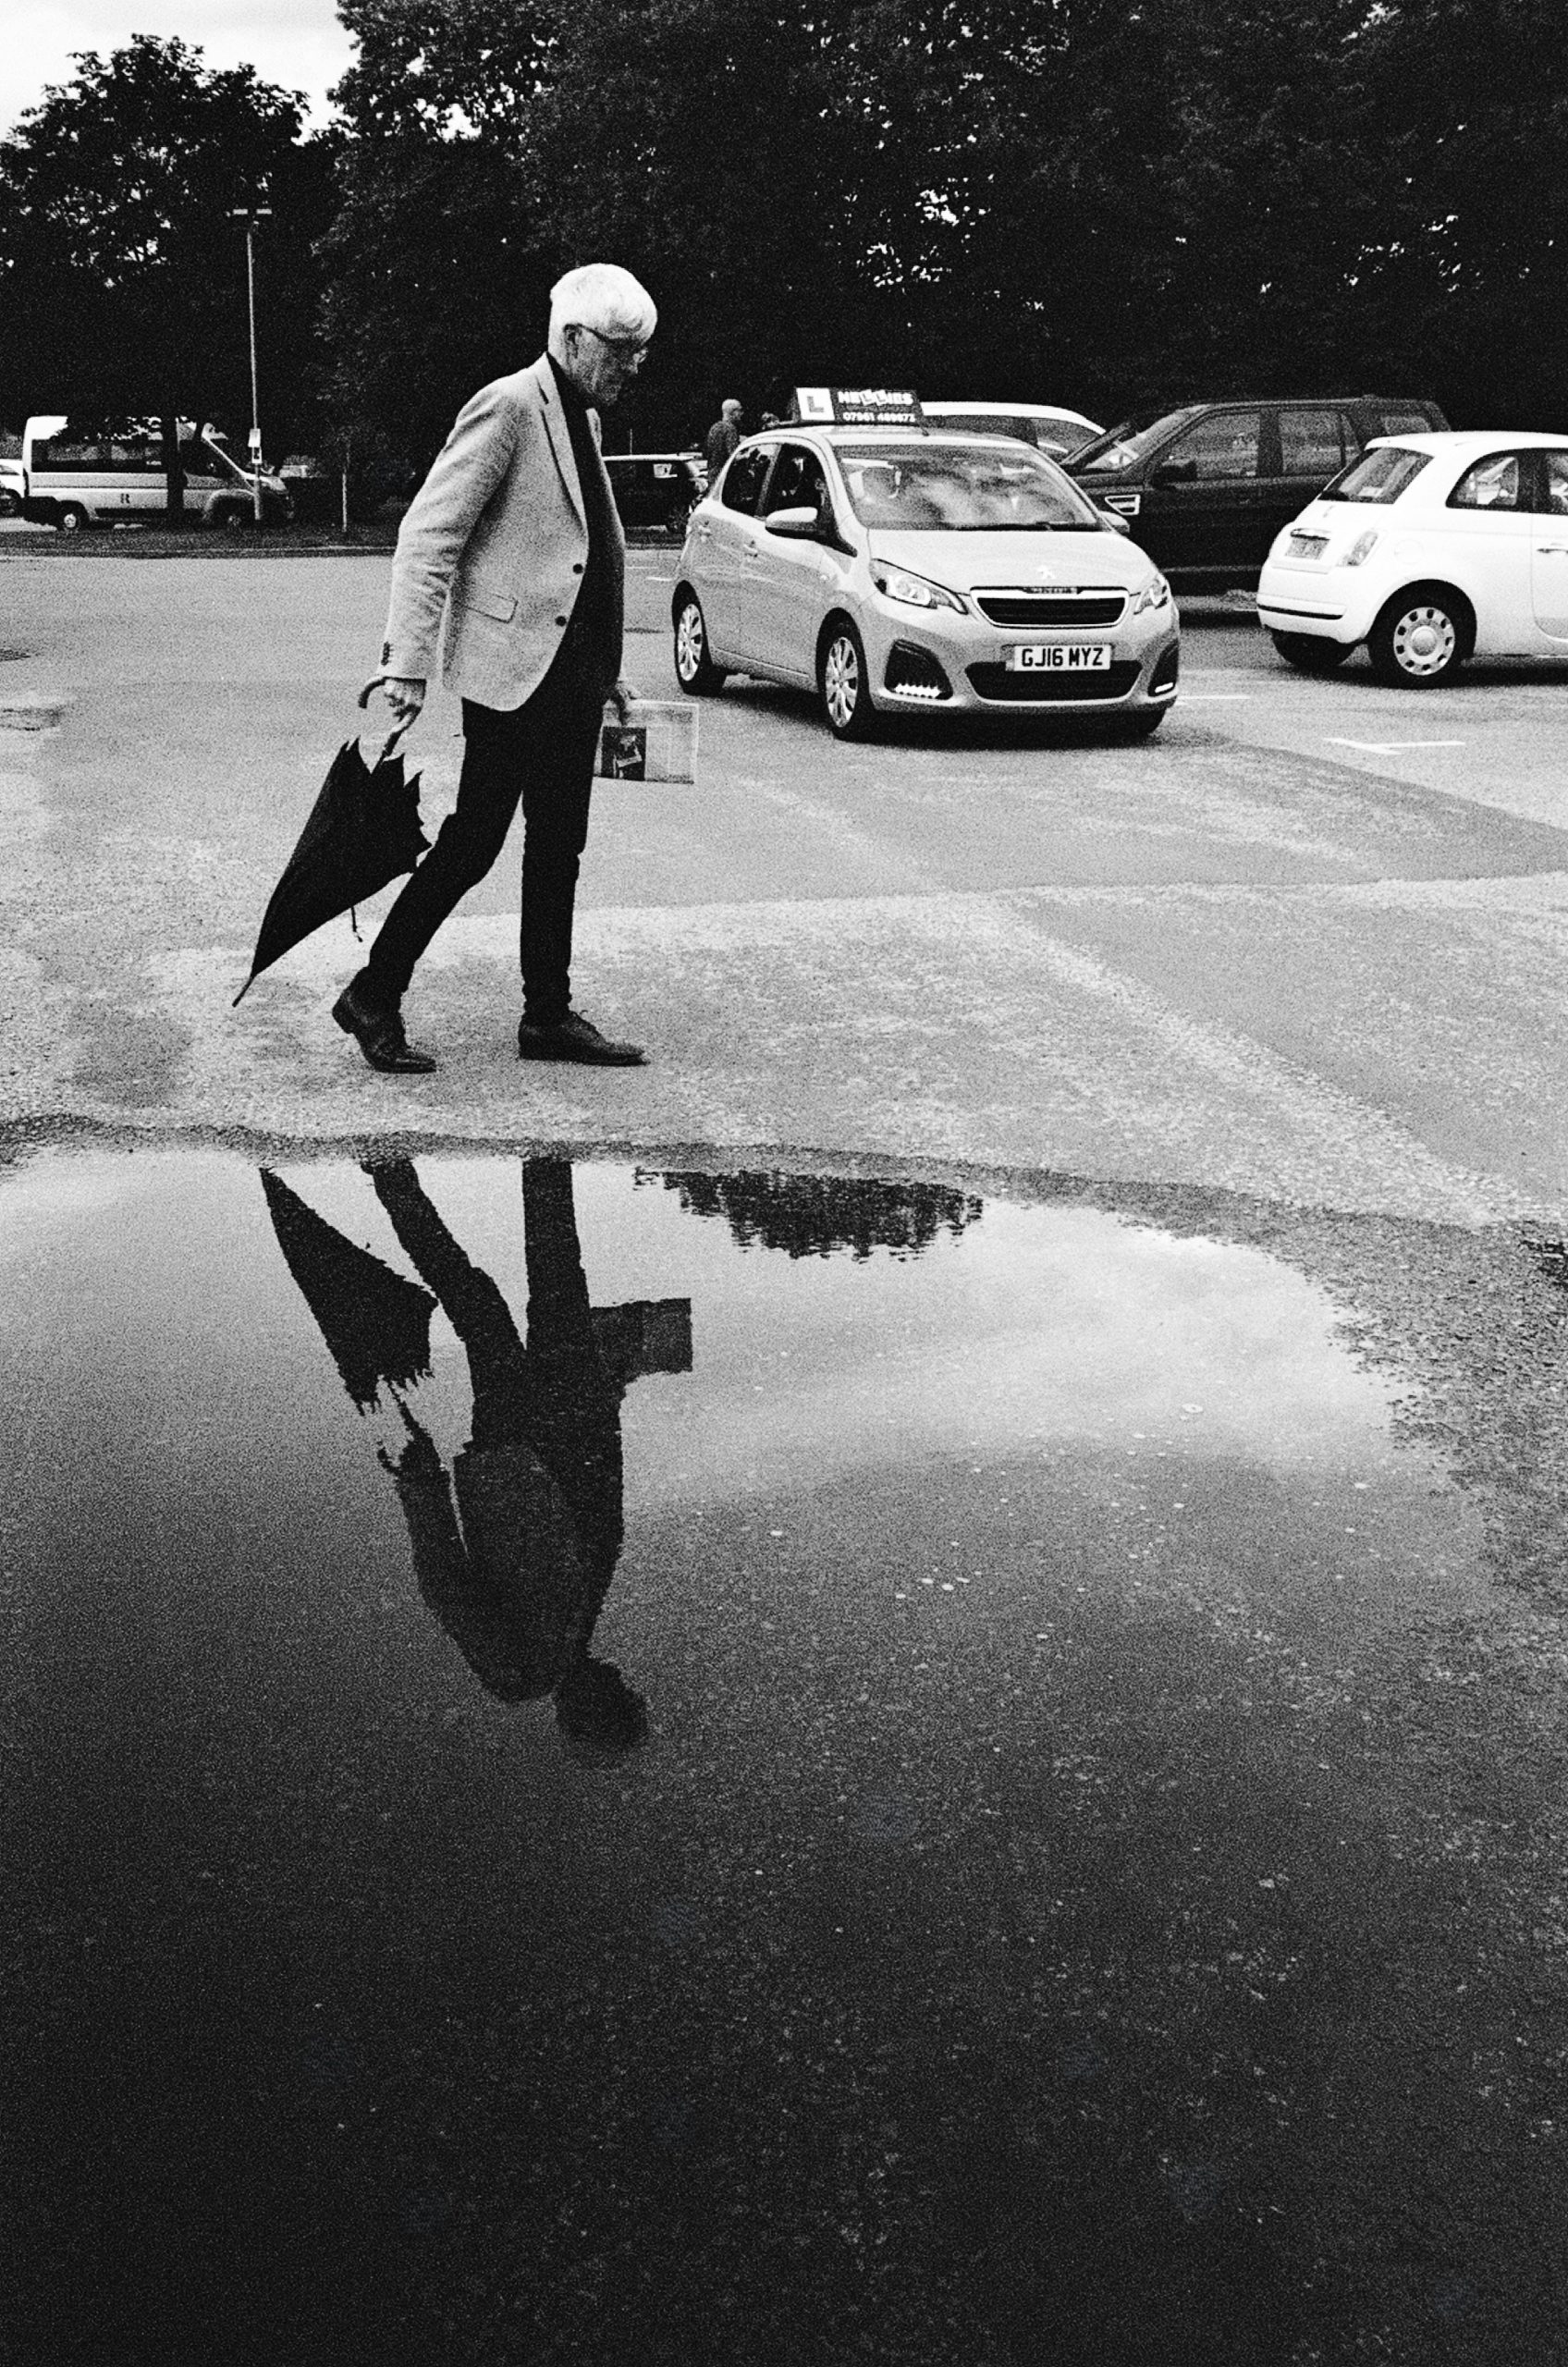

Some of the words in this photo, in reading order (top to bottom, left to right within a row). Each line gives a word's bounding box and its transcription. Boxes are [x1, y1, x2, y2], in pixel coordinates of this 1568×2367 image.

[806, 396, 825, 412] L
[1022, 648, 1063, 667] GJ16
[1069, 647, 1103, 667] MYZ
